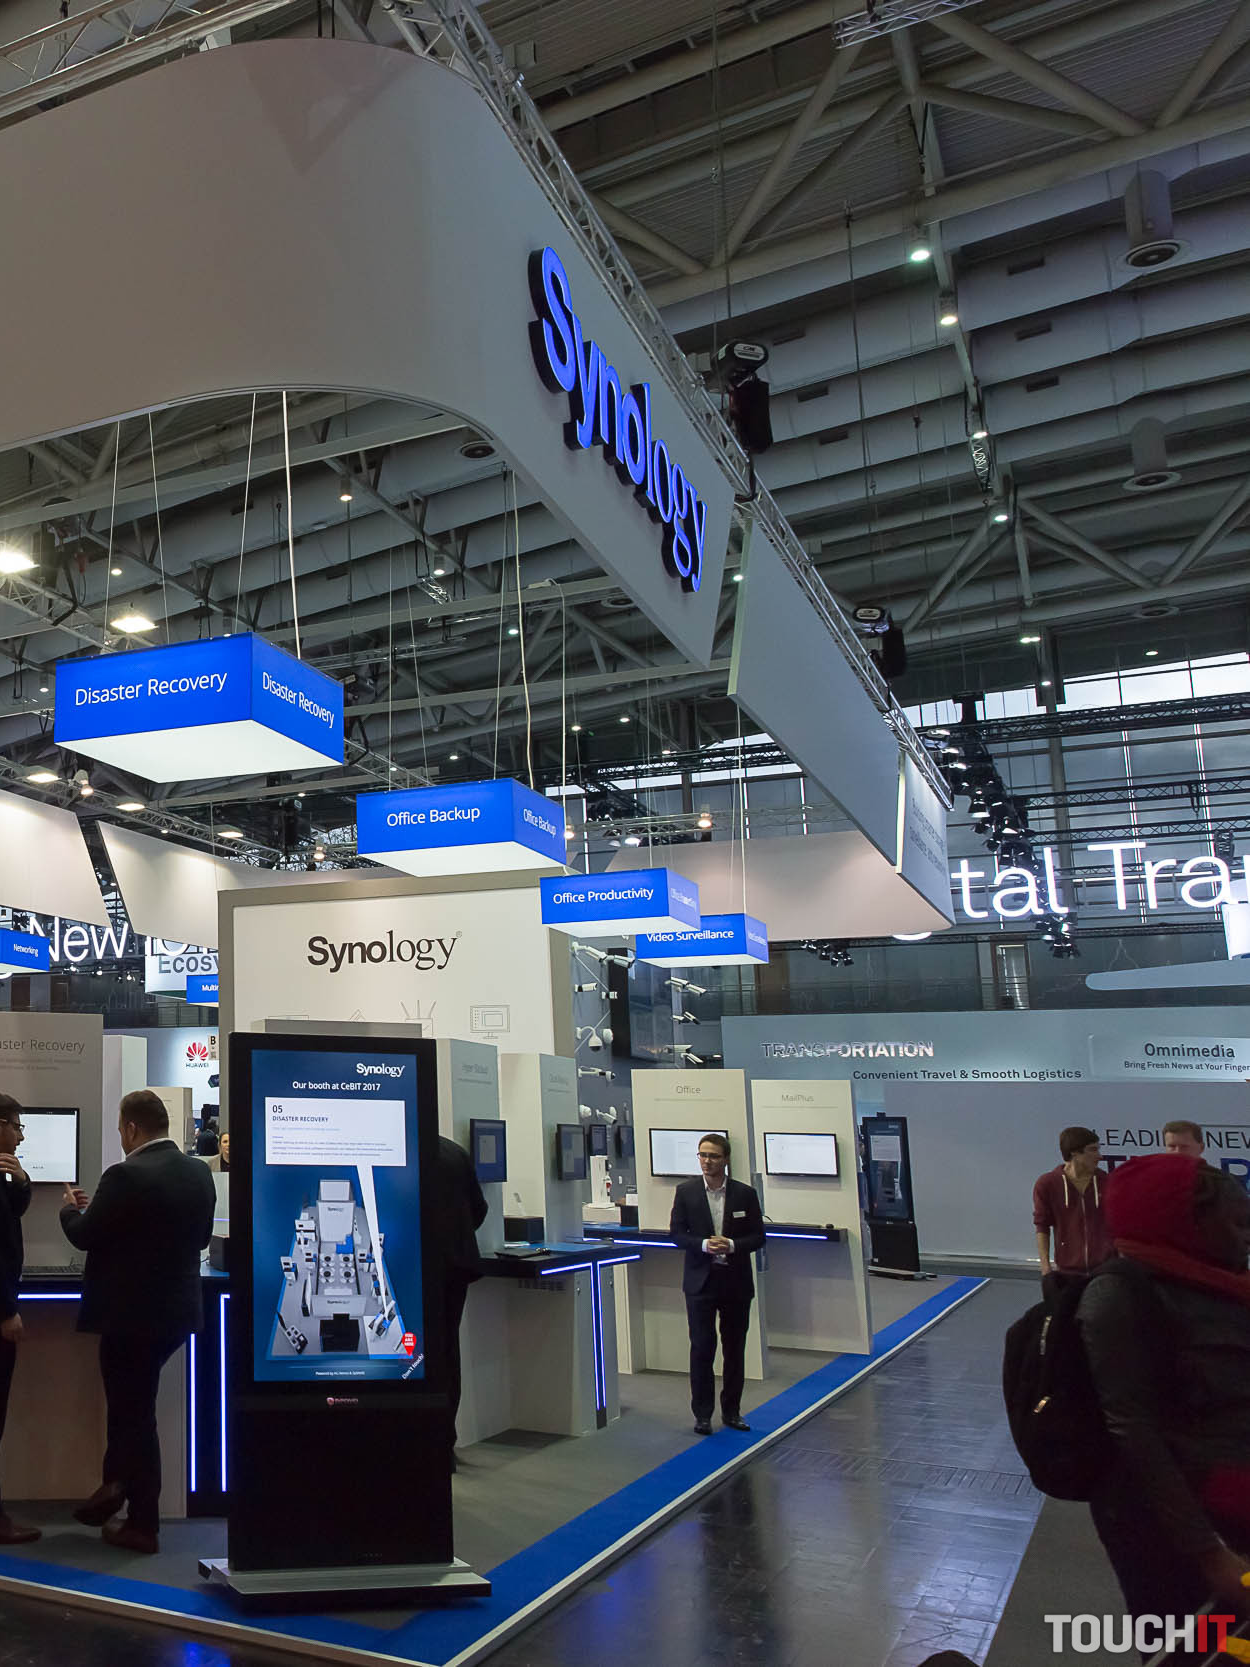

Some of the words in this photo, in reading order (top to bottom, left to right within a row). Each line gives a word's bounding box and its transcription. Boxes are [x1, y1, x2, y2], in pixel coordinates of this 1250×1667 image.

[529, 246, 707, 592] Synology
[75, 683, 140, 706] Disaster
[148, 672, 227, 696] Recovery
[262, 671, 296, 705] Disaster
[299, 691, 334, 729] Recovery
[386, 809, 426, 827] Office
[430, 806, 481, 824] Backup
[1087, 841, 1250, 911] Tra
[553, 892, 585, 904] Office
[588, 887, 654, 902] Productivity
[30, 916, 128, 962] New
[646, 931, 674, 943] Video
[676, 929, 734, 942] Surveillance
[13, 943, 39, 957] Networking
[30, 1039, 85, 1054] Recovery
[761, 1040, 934, 1059] TRANSPORTATION
[1144, 1042, 1236, 1058] Omnimedia
[356, 1063, 405, 1077] Synology
[1124, 1060, 1146, 1070] Bring
[1147, 1061, 1170, 1069] Fresh
[1171, 1062, 1193, 1070] News
[1205, 1063, 1223, 1071] Your
[852, 1070, 918, 1080] Convenient
[920, 1069, 956, 1080] Travel
[960, 1069, 968, 1080] &
[971, 1069, 1020, 1080] Smooth
[1024, 1068, 1082, 1081] Logistics
[292, 1081, 307, 1089] Our
[308, 1081, 330, 1090] booth
[340, 1082, 361, 1091] CeBIT
[362, 1083, 381, 1091] 2017
[676, 1085, 702, 1094] Office
[781, 1094, 815, 1103] MailPlus
[272, 1105, 283, 1113] 05
